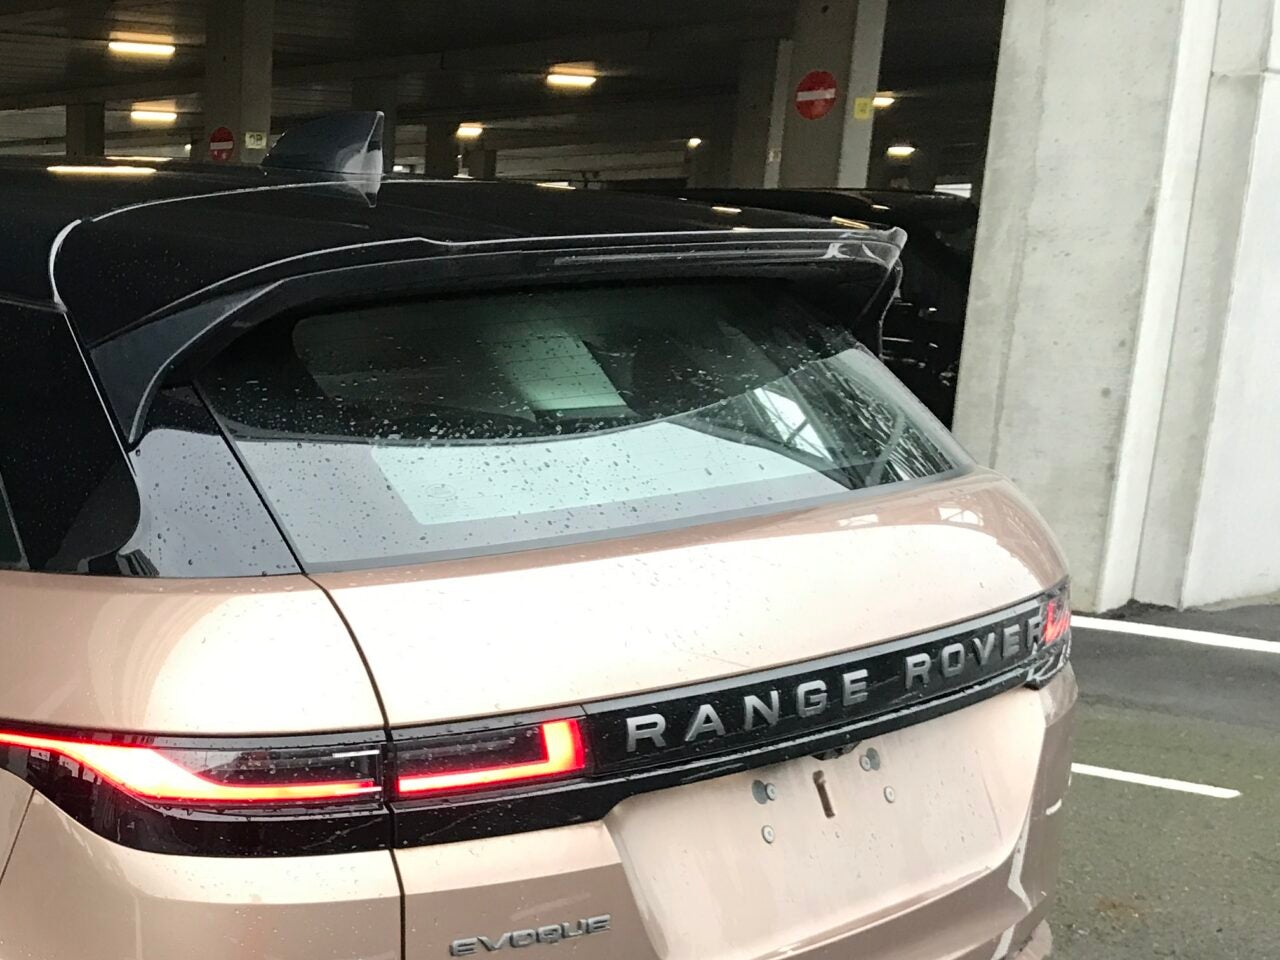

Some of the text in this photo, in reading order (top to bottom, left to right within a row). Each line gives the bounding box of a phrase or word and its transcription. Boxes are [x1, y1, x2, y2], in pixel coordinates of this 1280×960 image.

[626, 615, 1043, 752] RANGE ROVER
[449, 913, 611, 957] EVOQUE
